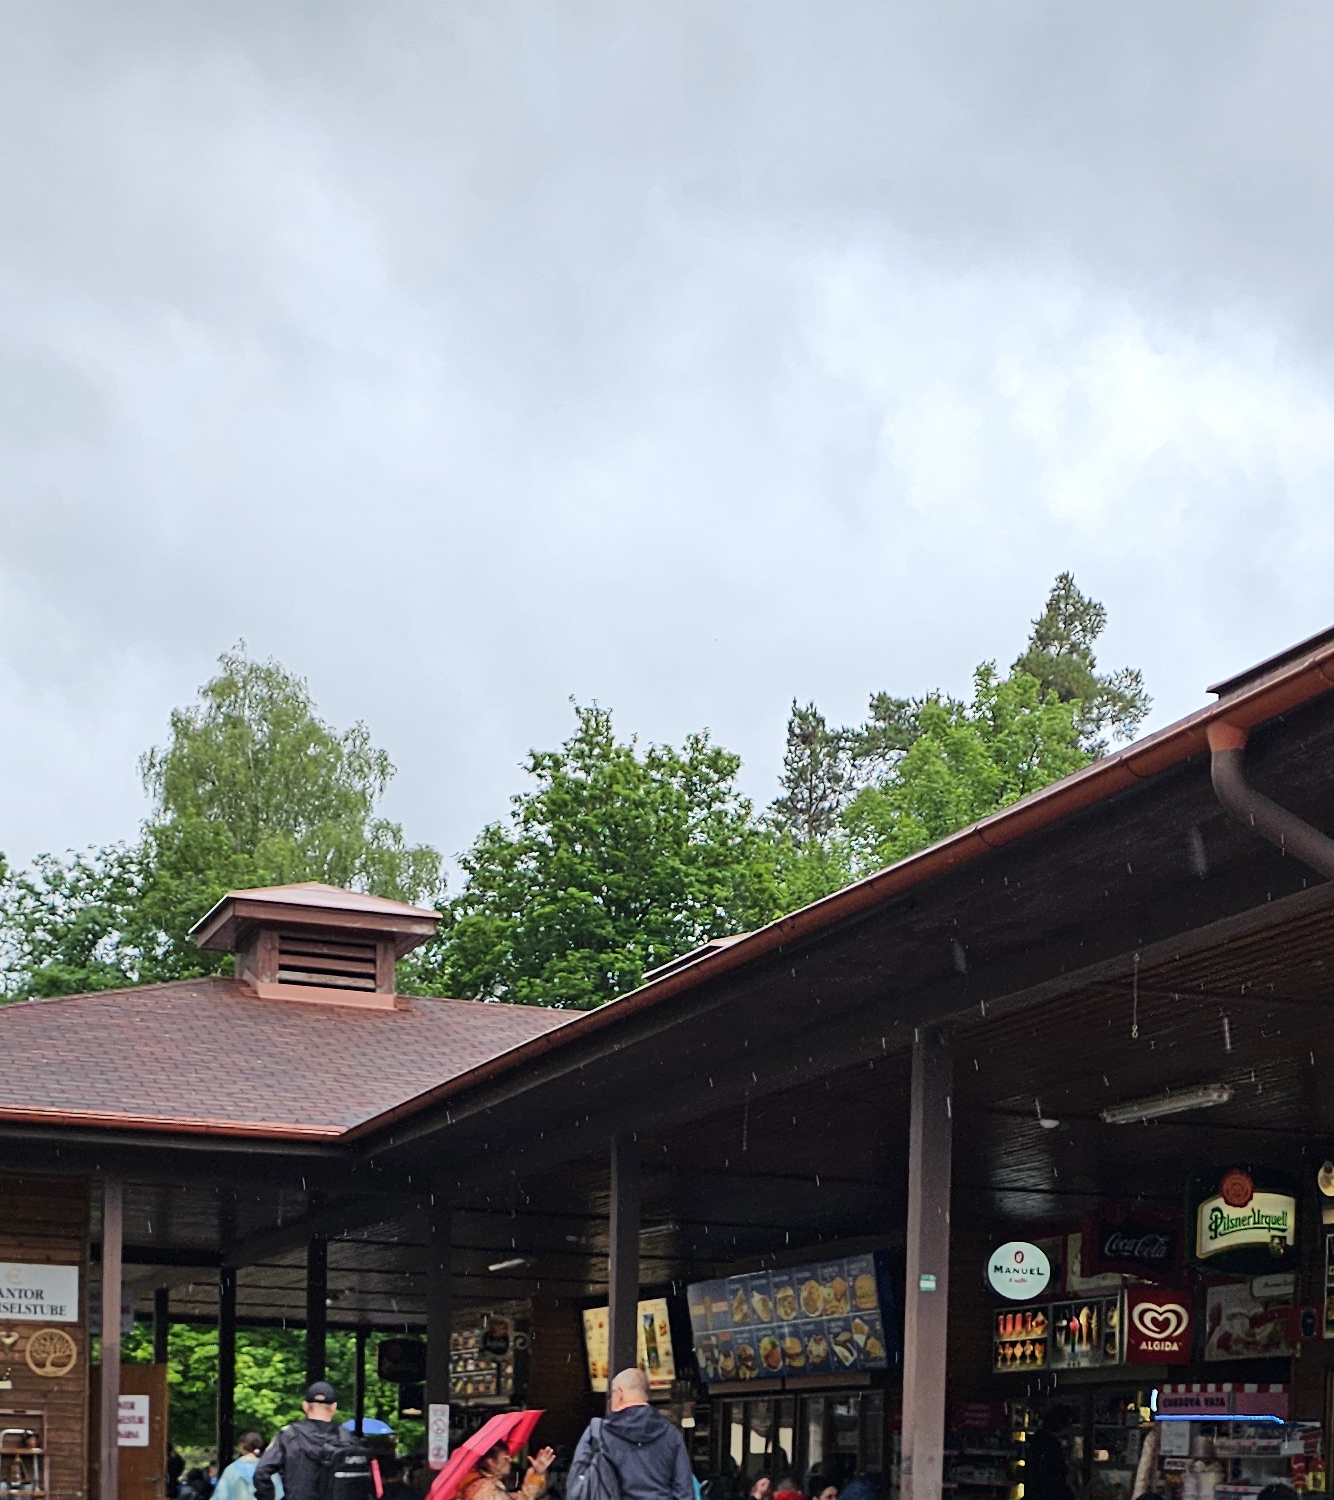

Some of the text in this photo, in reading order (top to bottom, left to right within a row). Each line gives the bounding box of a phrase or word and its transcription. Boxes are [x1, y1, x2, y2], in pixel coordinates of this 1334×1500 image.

[1208, 1206, 1288, 1241] Pilsner Urquell
[1104, 1231, 1171, 1259] Coca-Cola
[993, 1265, 1045, 1276] MANUEL
[1139, 1341, 1180, 1351] ALGIDA
